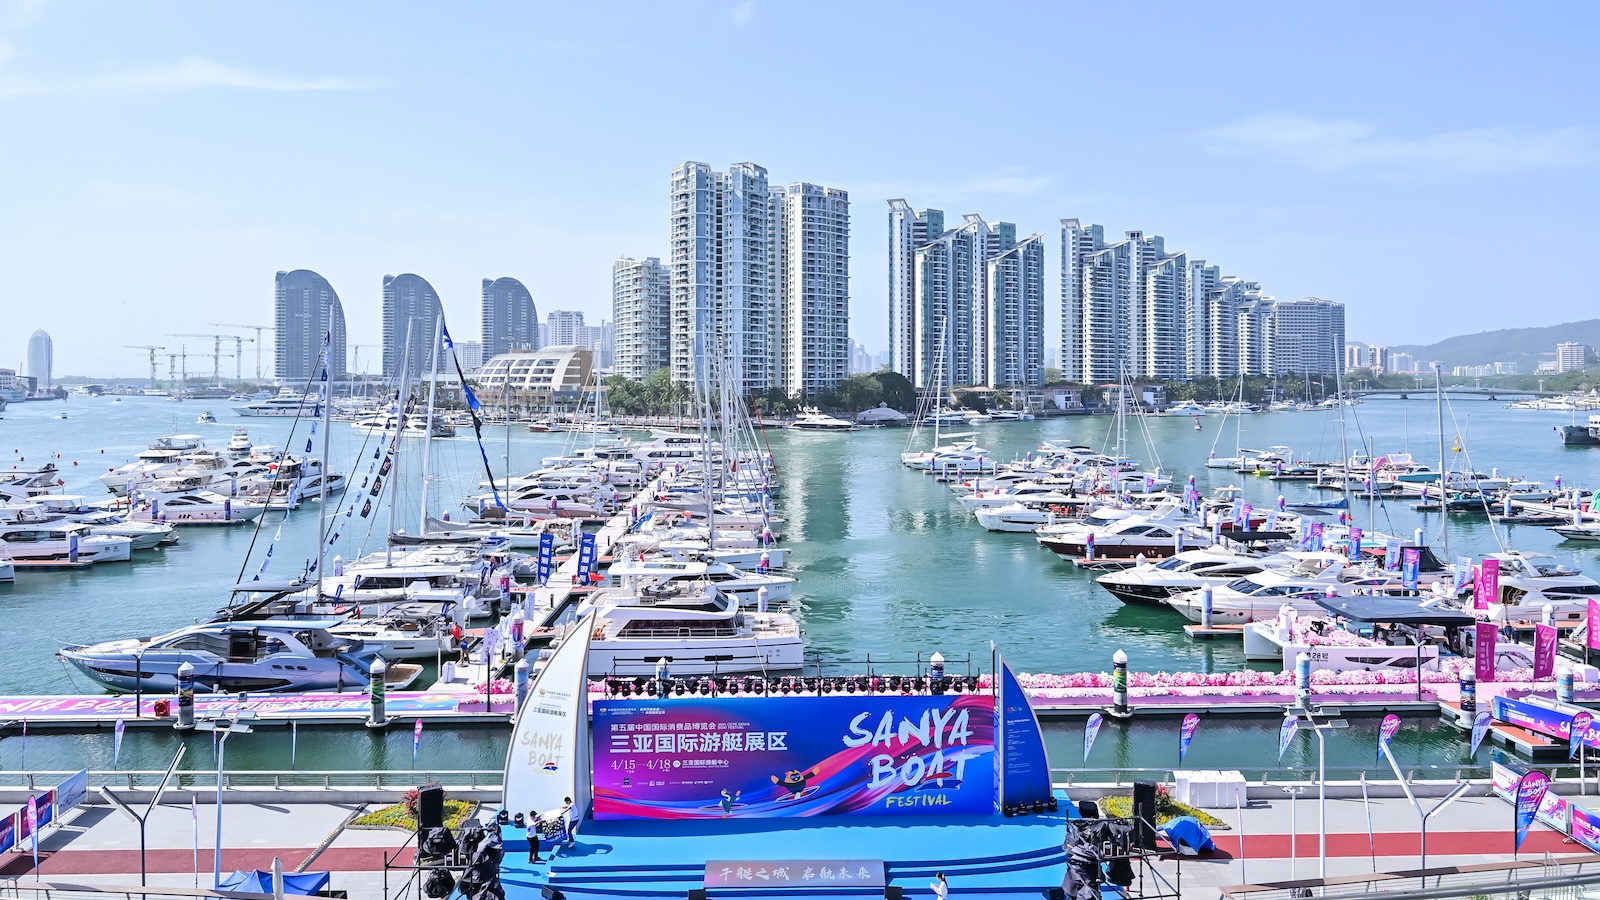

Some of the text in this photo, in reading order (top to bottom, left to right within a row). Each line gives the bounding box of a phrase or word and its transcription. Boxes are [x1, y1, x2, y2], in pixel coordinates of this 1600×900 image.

[610, 722, 717, 732] 第五届中国国际消费品博览会
[842, 707, 974, 749] SANYA
[521, 730, 563, 751] SANYA
[610, 732, 788, 753] 三亚国际游艇展区
[527, 750, 564, 767] BOAT
[610, 759, 671, 770] 4/15 4/18
[867, 749, 981, 788] BOAT
[1521, 778, 1546, 789] SANYA
[886, 794, 952, 808] FESTIVAL
[719, 866, 871, 882] 千艇之城 启航未来
